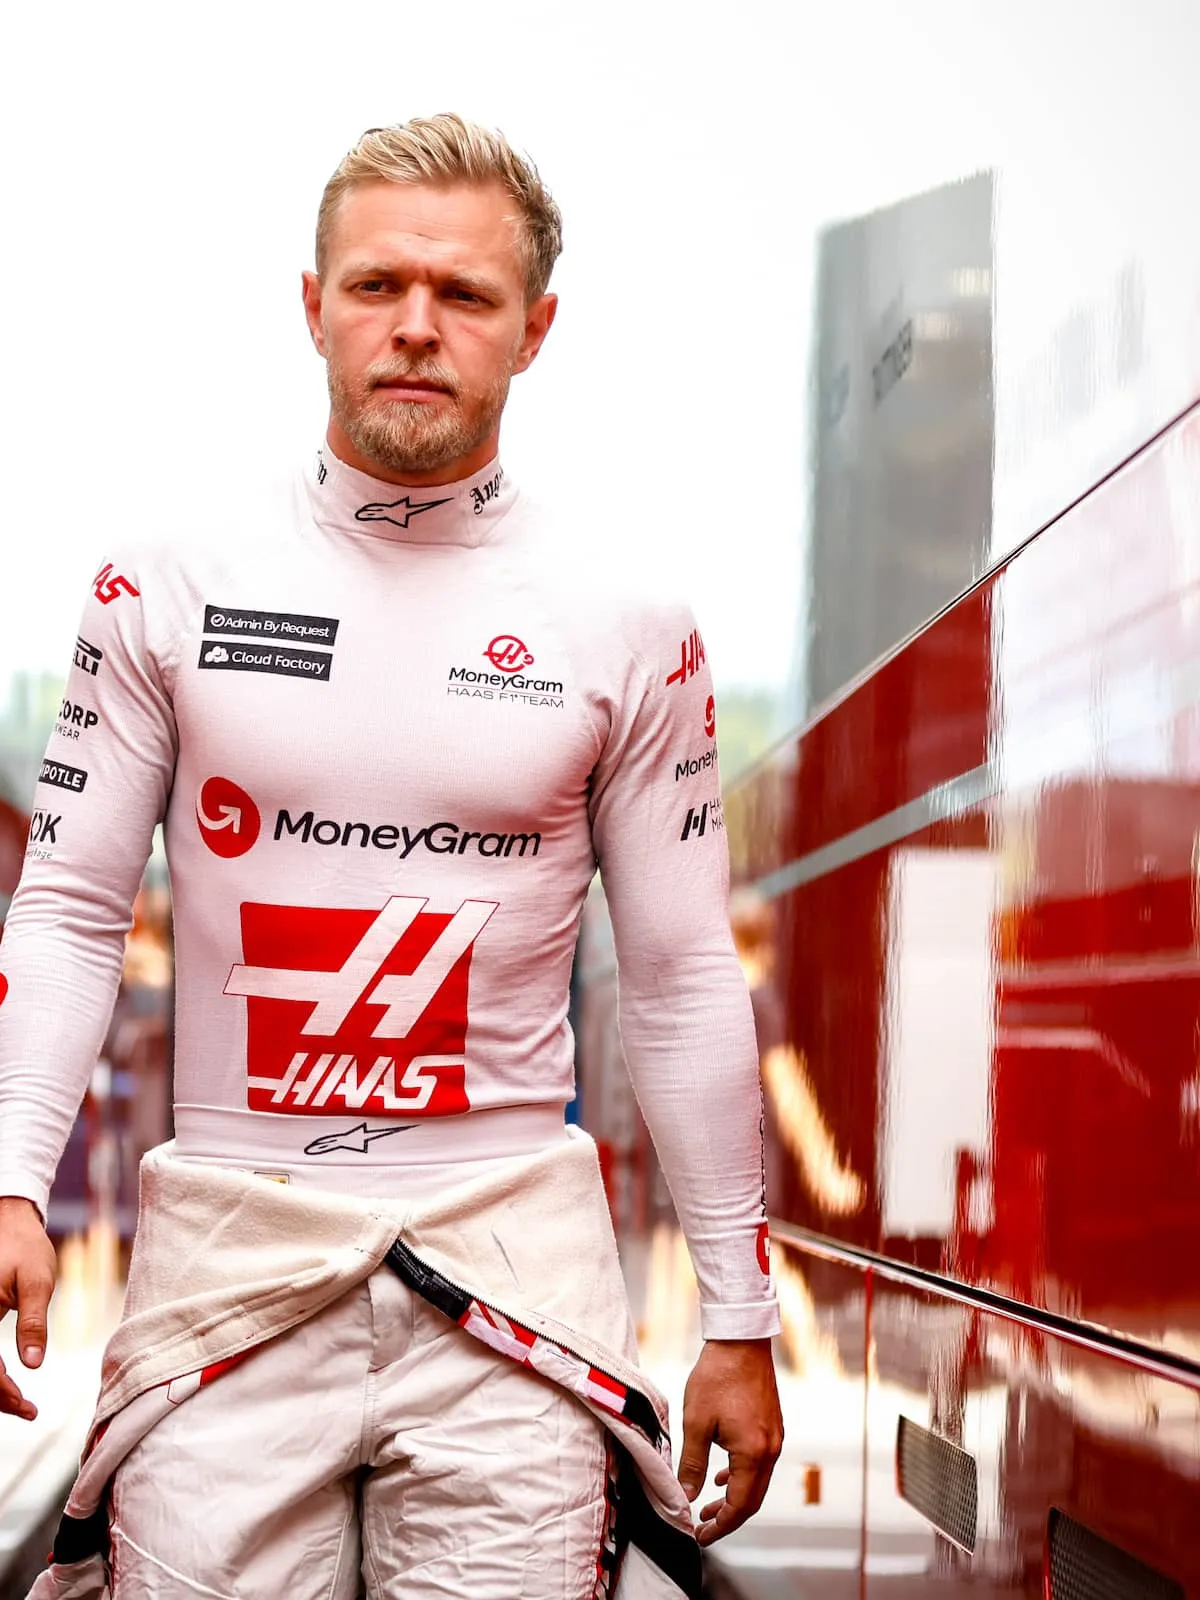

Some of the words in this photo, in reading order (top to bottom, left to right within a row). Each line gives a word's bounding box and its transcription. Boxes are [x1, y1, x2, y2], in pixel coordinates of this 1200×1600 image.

[224, 617, 261, 631] Admin
[264, 620, 280, 633] By
[280, 622, 329, 637] Request
[232, 651, 272, 665] Cloud
[275, 655, 325, 674] Factory
[449, 667, 563, 693] MoneyGram
[447, 687, 494, 700] HAAS
[29, 811, 62, 843] OK
[274, 809, 541, 859] MoneyGram
[248, 1052, 466, 1111] HAAS
